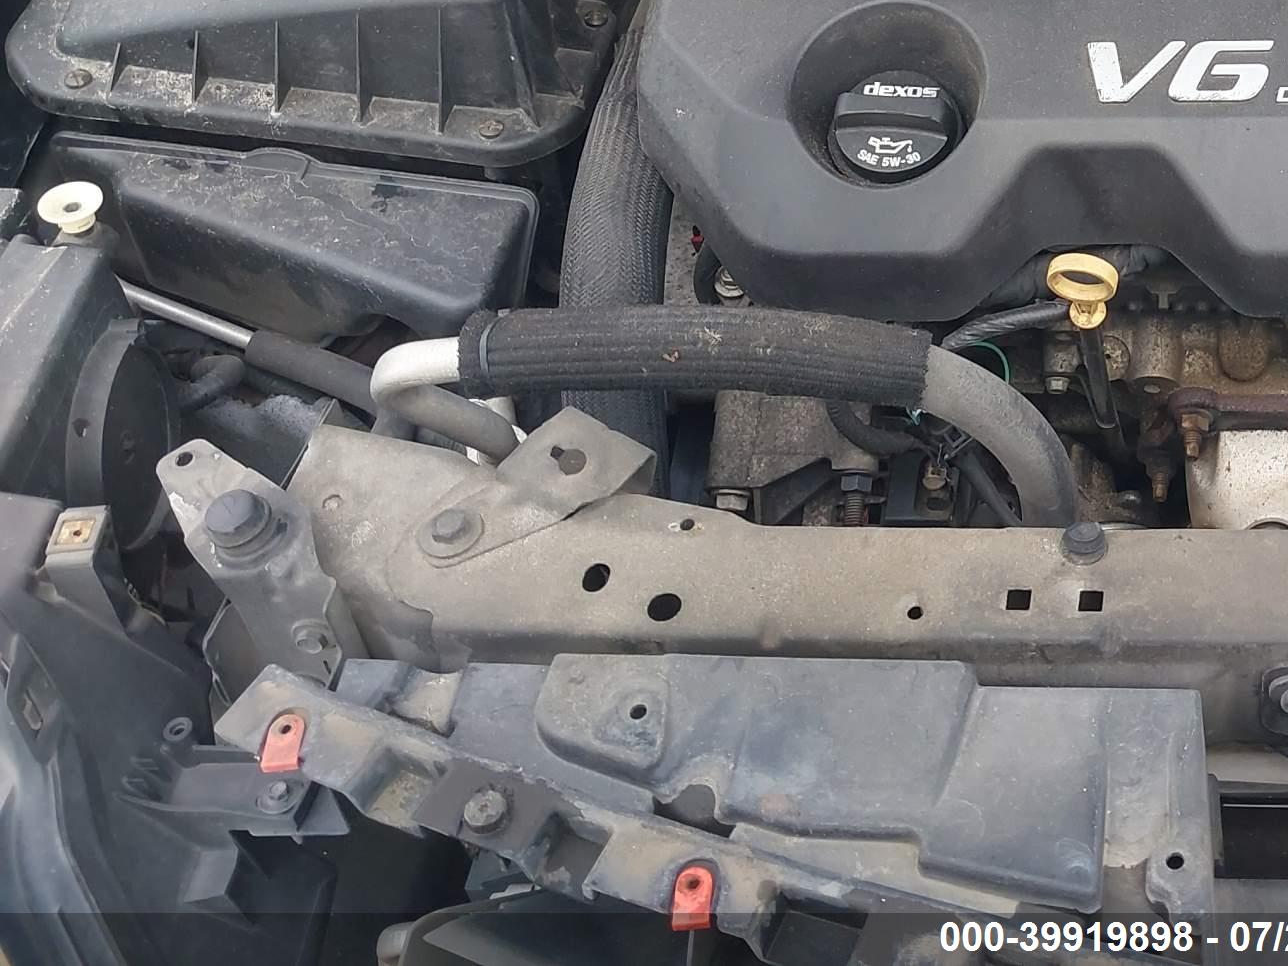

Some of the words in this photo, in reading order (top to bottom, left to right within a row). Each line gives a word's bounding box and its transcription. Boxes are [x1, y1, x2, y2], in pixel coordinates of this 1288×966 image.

[1087, 40, 1275, 103] V6
[863, 81, 941, 99] dexos
[857, 149, 880, 166] SAE
[881, 151, 921, 167] 5W-30
